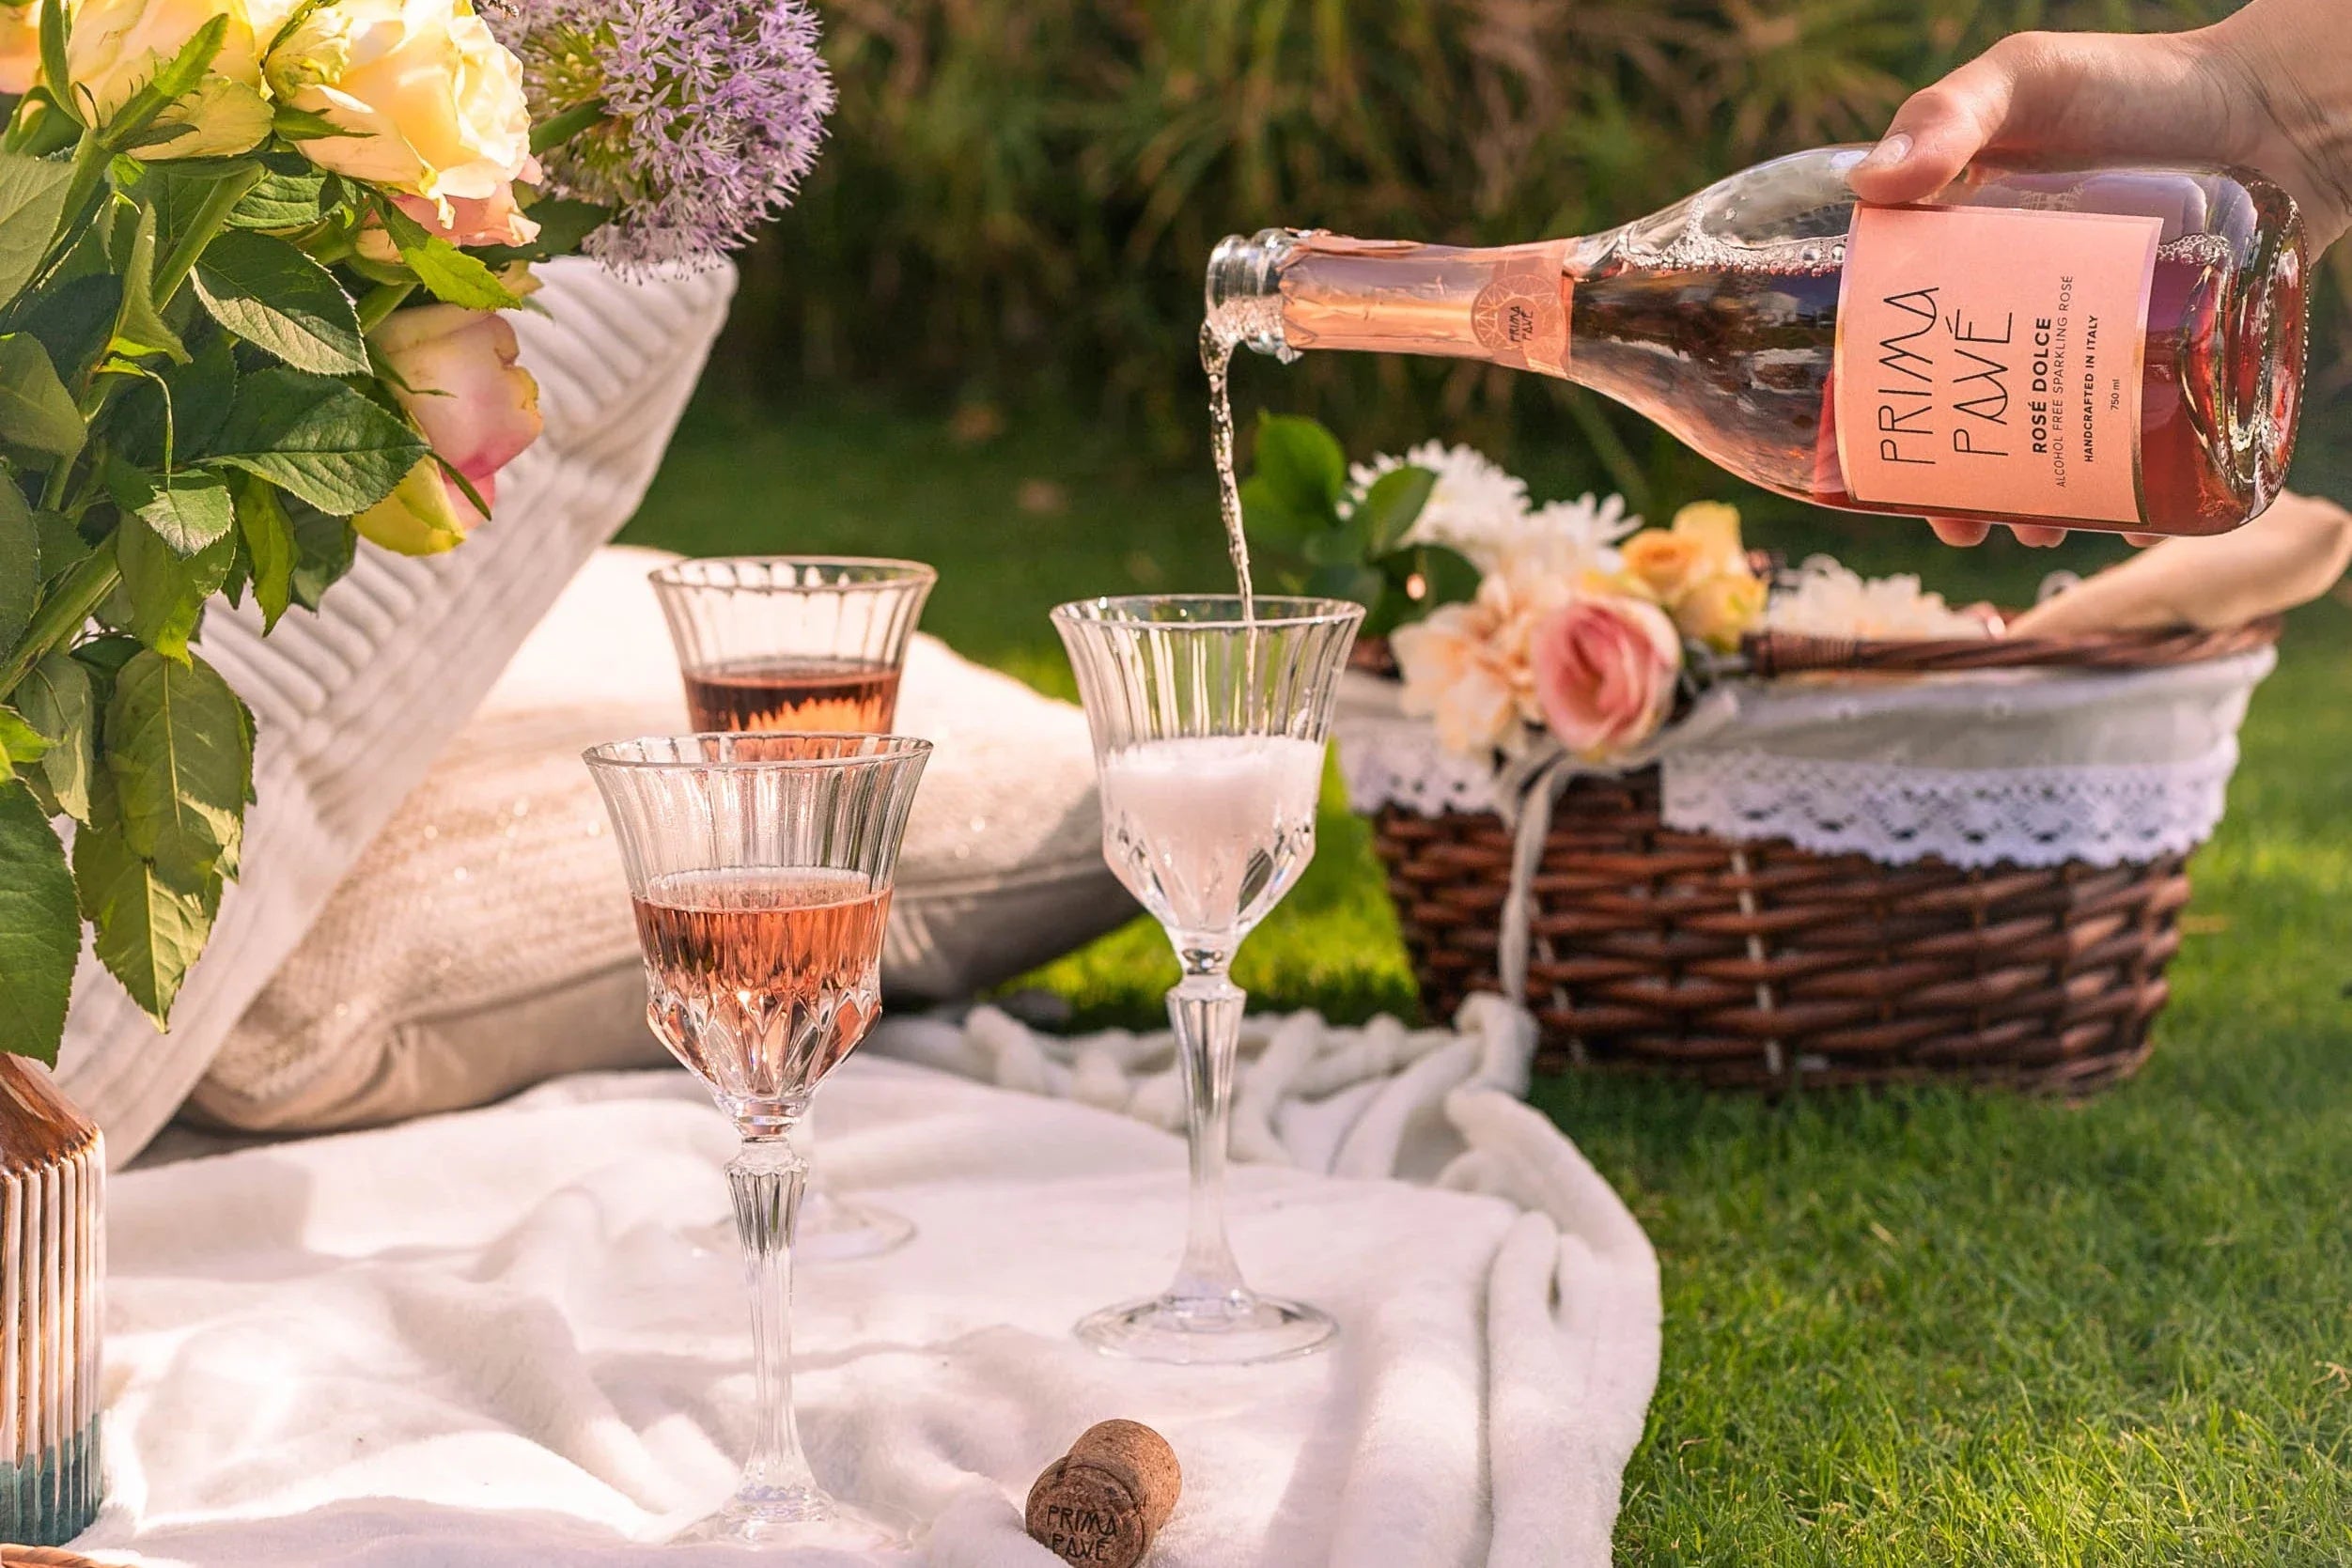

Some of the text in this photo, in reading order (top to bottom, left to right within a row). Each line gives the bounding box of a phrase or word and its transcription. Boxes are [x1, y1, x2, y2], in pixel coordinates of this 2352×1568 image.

[1509, 305, 1520, 343] PRIMA
[1877, 287, 1940, 465] PRIMA
[1944, 308, 2014, 457] PAVÉ
[2028, 318, 2051, 454] ROSÉ DOLCE
[2052, 275, 2074, 488] ALCOHOL FREE SPARKLING ROSÉ
[2083, 315, 2098, 462] HANDCRAFTED IN ITALY
[2111, 378, 2121, 411] 750 ml
[1047, 1505, 1117, 1538] PRIMA
